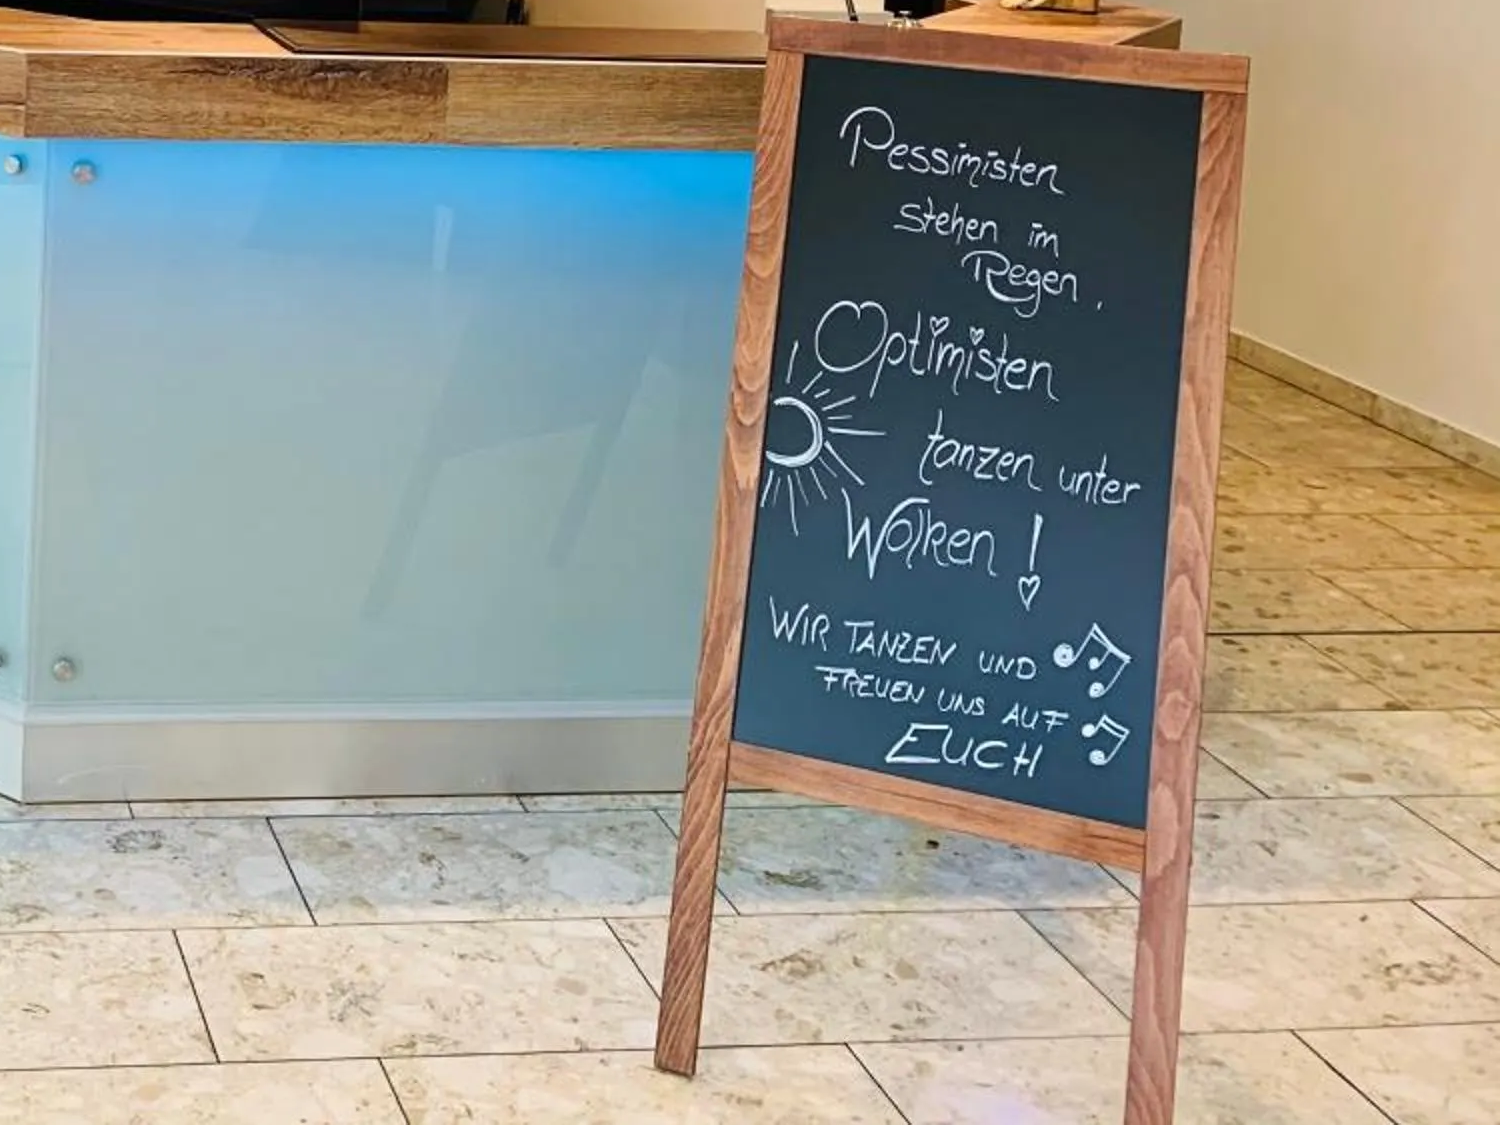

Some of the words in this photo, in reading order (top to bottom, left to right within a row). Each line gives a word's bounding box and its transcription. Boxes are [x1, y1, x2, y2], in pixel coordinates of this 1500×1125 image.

[839, 105, 1065, 195] Pessimisten
[1027, 222, 1060, 258] im
[814, 300, 1060, 403] Optimisten
[918, 408, 1043, 492] tanzen
[1058, 453, 1142, 506] unter
[841, 487, 998, 580] Wolken
[769, 595, 831, 653] WIR
[843, 620, 958, 667] TANZEN
[978, 652, 1038, 681] UND
[814, 665, 927, 705] FREUEN
[936, 689, 986, 718] UNS
[1000, 701, 1070, 734] AUF
[884, 721, 1044, 779] EUCH
